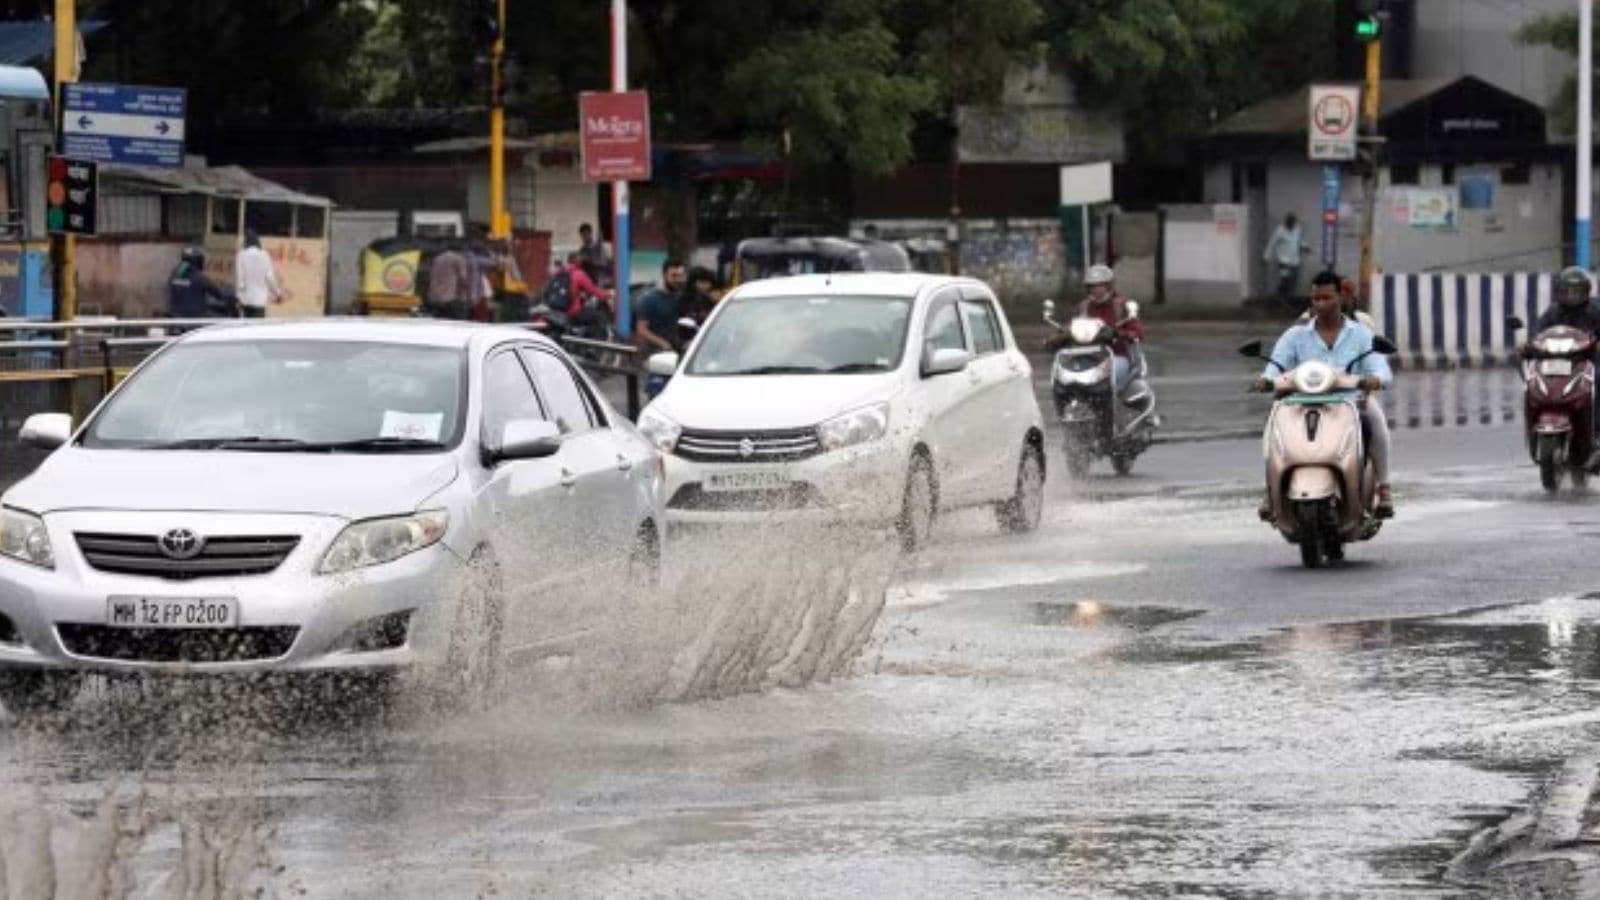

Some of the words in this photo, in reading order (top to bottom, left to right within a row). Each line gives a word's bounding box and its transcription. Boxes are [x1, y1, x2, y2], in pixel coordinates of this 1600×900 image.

[114, 603, 135, 624] MH
[142, 604, 159, 624] 12
[163, 604, 182, 624] FP
[186, 604, 229, 624] 0200
